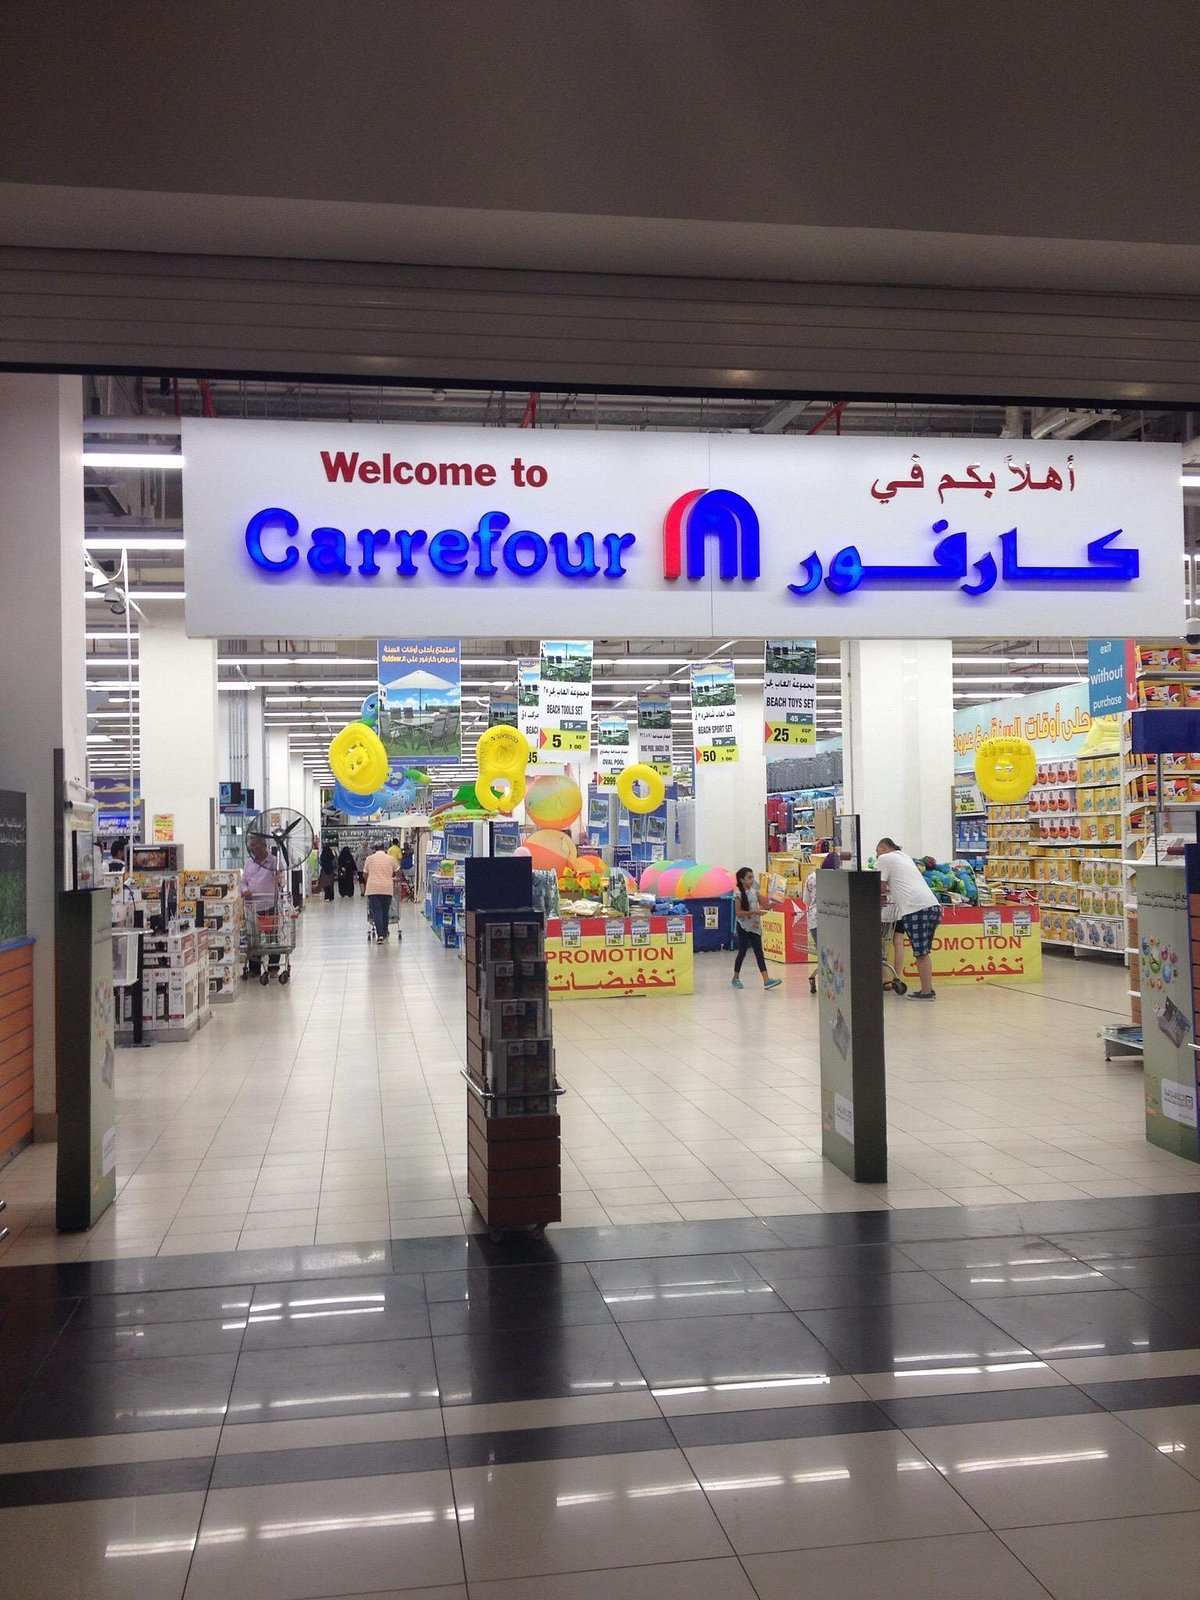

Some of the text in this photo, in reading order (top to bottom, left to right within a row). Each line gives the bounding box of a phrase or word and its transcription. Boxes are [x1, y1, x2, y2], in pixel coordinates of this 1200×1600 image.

[321, 451, 548, 488] Welcome to
[871, 453, 924, 504] في
[938, 461, 996, 504] بكم
[245, 507, 636, 580] Carrefour
[787, 518, 1139, 596] كارفور
[1100, 641, 1112, 655] exit
[1090, 665, 1123, 685] without
[547, 704, 583, 715] BEACH TOOLS SET
[766, 697, 814, 708] BEACH TOYS SET
[1093, 695, 1122, 712] purchase
[698, 726, 711, 734] BEACH
[712, 725, 724, 733] SPORT
[1025, 703, 1061, 743] أوقات
[552, 734, 562, 748] 5
[773, 728, 789, 742] 25
[953, 731, 973, 756] عرو
[703, 750, 716, 762] 50
[903, 936, 1022, 950] POMOTION
[545, 947, 674, 964] PROMOTION
[903, 955, 1024, 982] تخفيضت
[548, 968, 677, 995] تخفيضات
